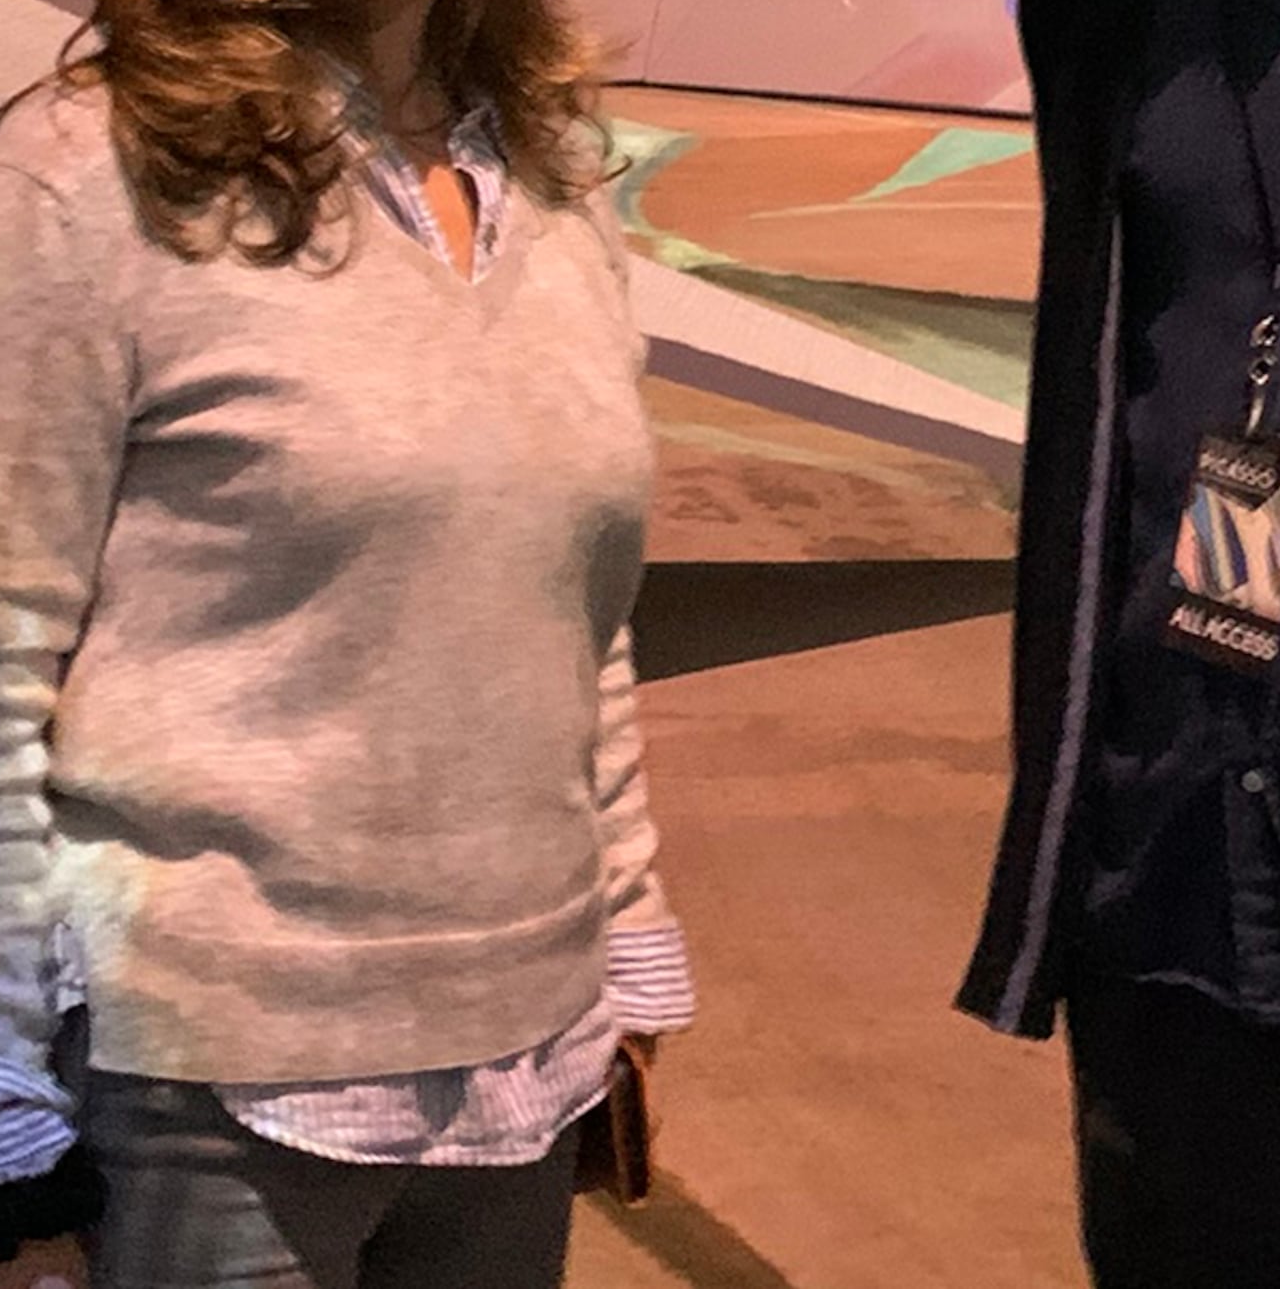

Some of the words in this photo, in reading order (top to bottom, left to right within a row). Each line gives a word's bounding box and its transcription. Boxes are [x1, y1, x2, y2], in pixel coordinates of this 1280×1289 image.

[1199, 451, 1277, 488] PICASSO
[1168, 605, 1204, 635] ALL
[1202, 615, 1279, 661] ACCESS
